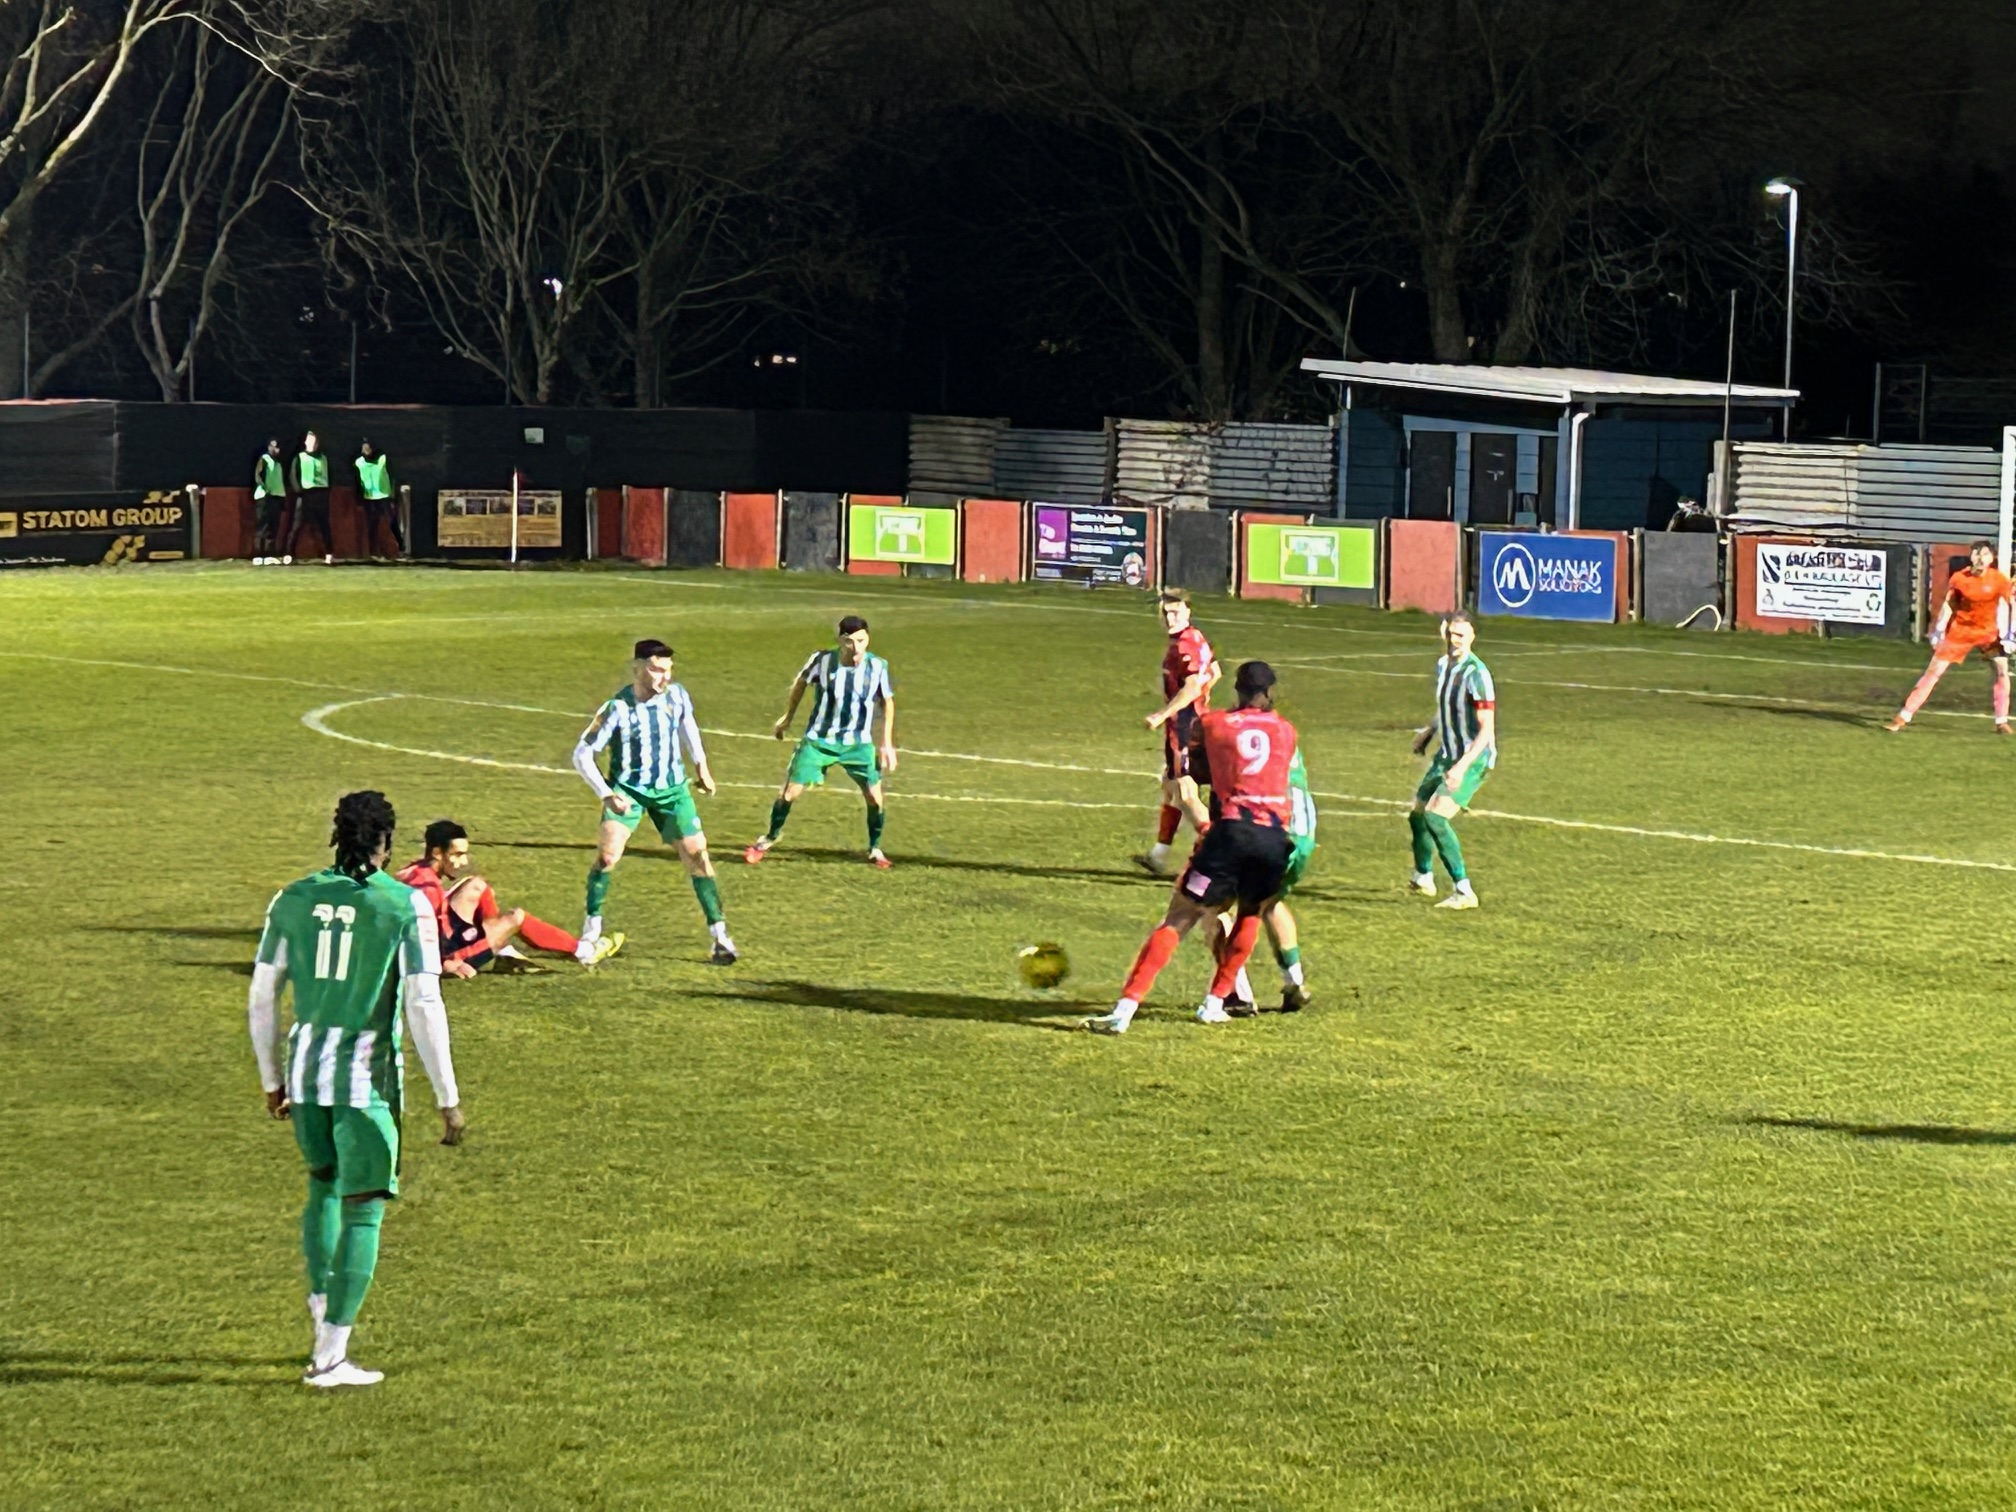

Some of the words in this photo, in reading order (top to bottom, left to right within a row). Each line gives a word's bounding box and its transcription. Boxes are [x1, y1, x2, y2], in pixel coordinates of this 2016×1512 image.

[23, 508, 108, 530] STATOM
[112, 506, 182, 527] GROUP
[1538, 558, 1602, 582] MANAK
[1236, 729, 1271, 775] 9
[312, 904, 356, 981] 11
